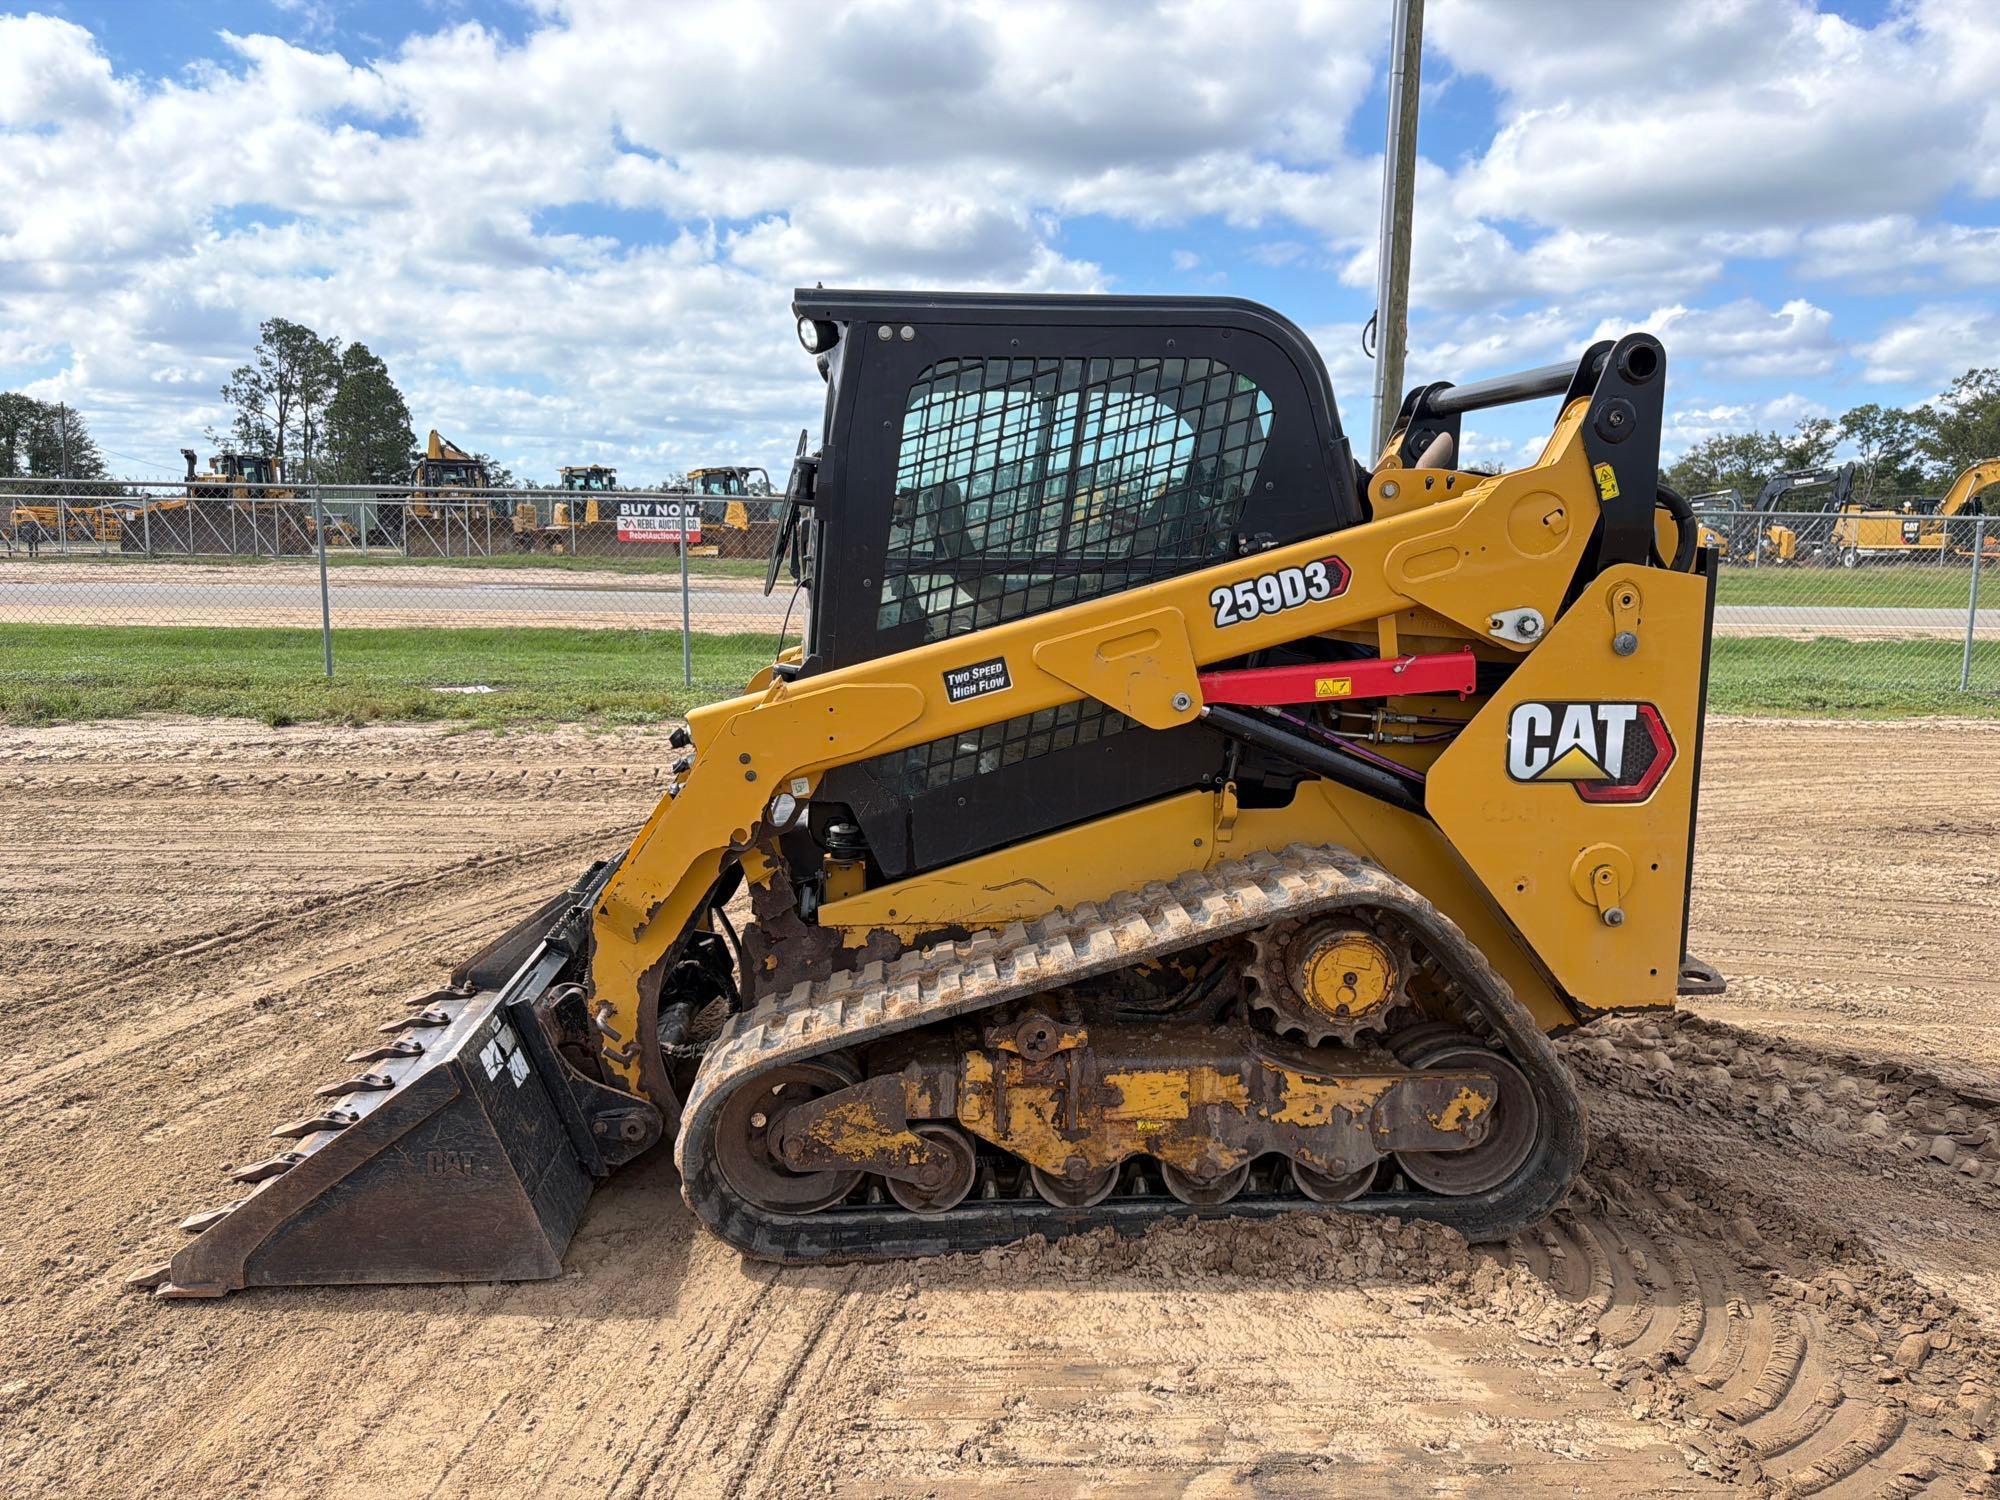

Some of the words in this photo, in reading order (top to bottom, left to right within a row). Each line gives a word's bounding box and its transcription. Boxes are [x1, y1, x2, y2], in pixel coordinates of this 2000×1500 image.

[620, 503, 651, 516] BUY
[637, 519, 656, 529] REBEL
[687, 520, 699, 530] CO.
[1904, 522, 1919, 532] CAT
[1211, 562, 1331, 626] 259D3
[1509, 703, 1637, 780] CAT
[427, 1151, 475, 1178] CAT
